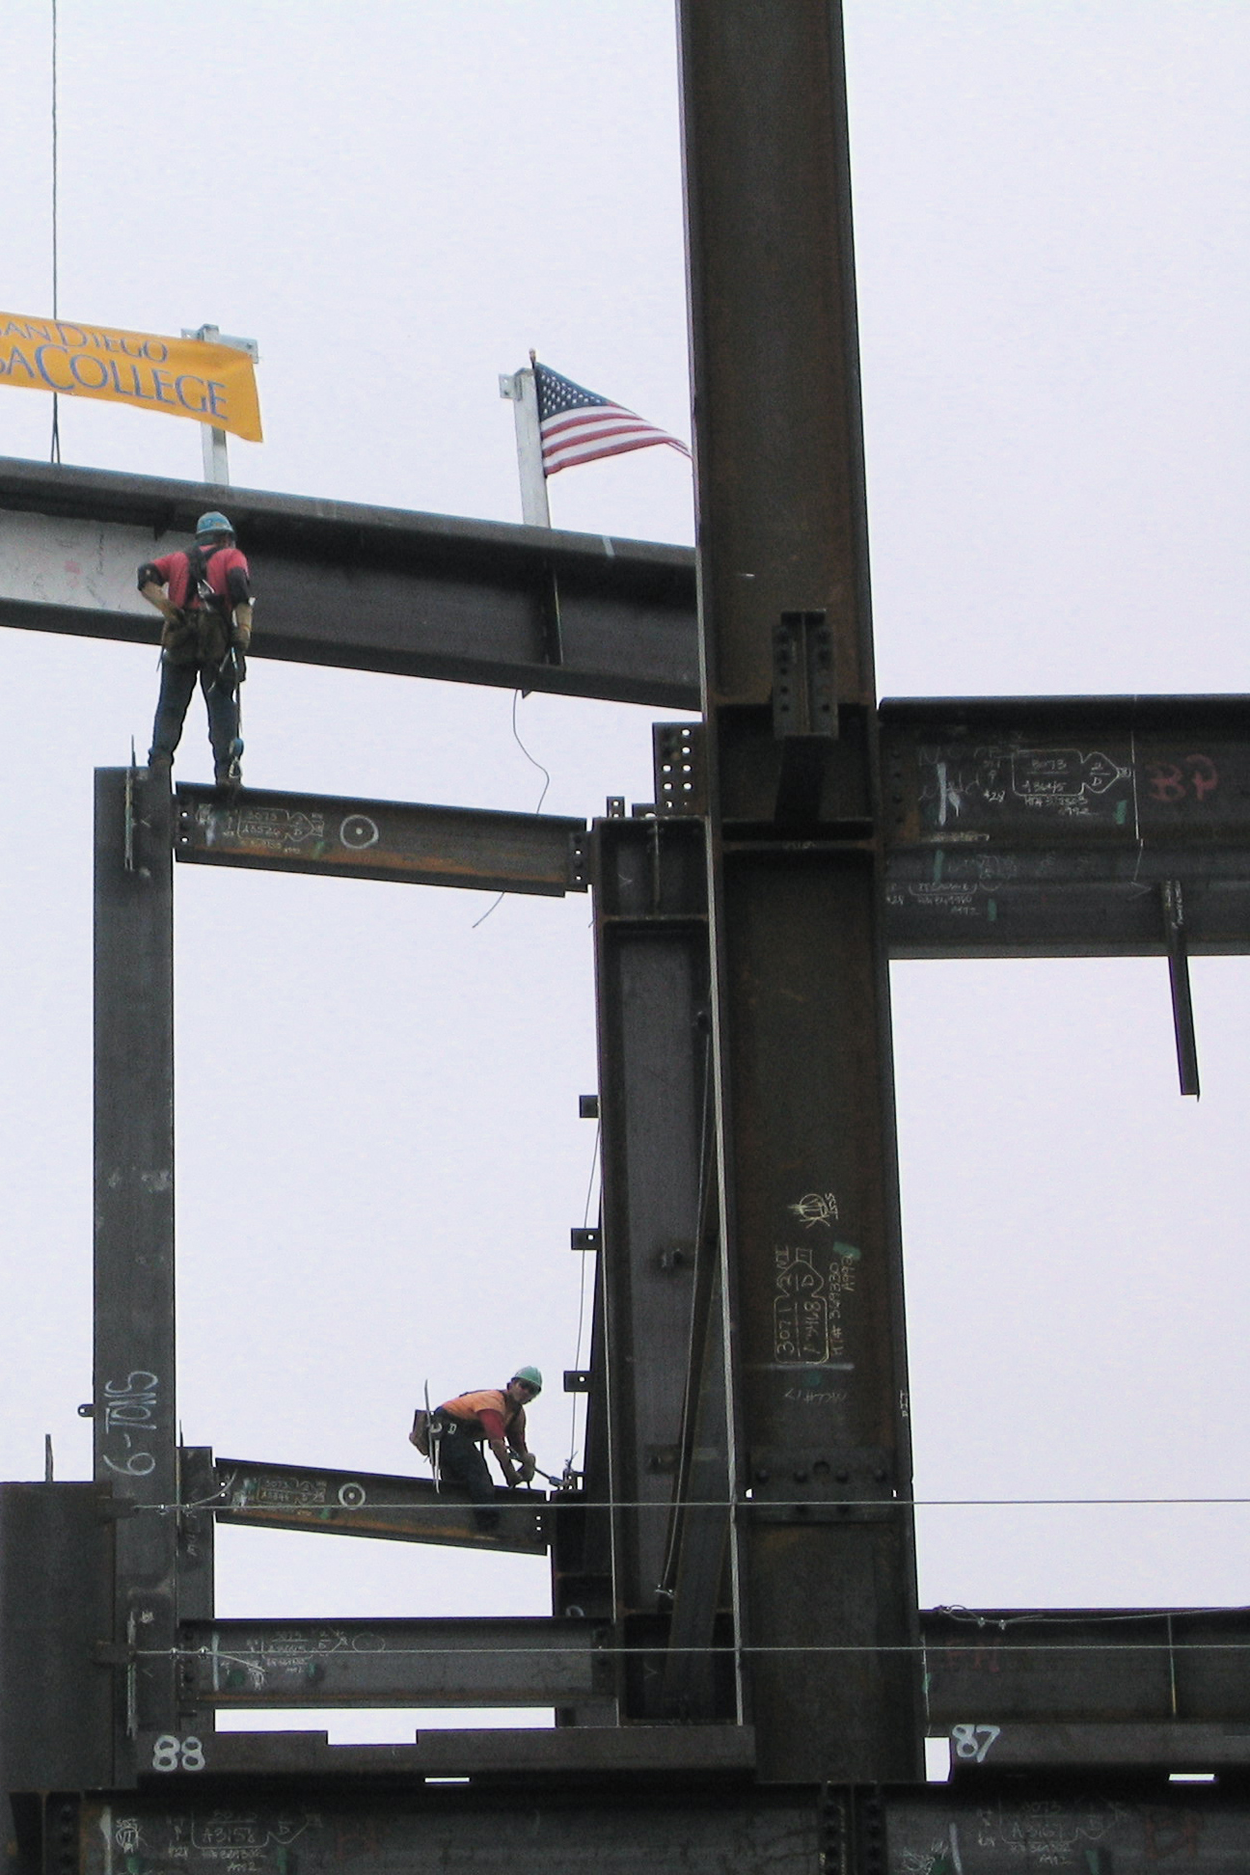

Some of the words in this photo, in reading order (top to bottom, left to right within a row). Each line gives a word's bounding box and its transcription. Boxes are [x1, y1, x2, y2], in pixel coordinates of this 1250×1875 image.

[55, 322, 169, 364] DIEGO
[34, 343, 229, 420] COLLEGE
[152, 1734, 206, 1773] 88
[951, 1723, 1001, 1763] 87
